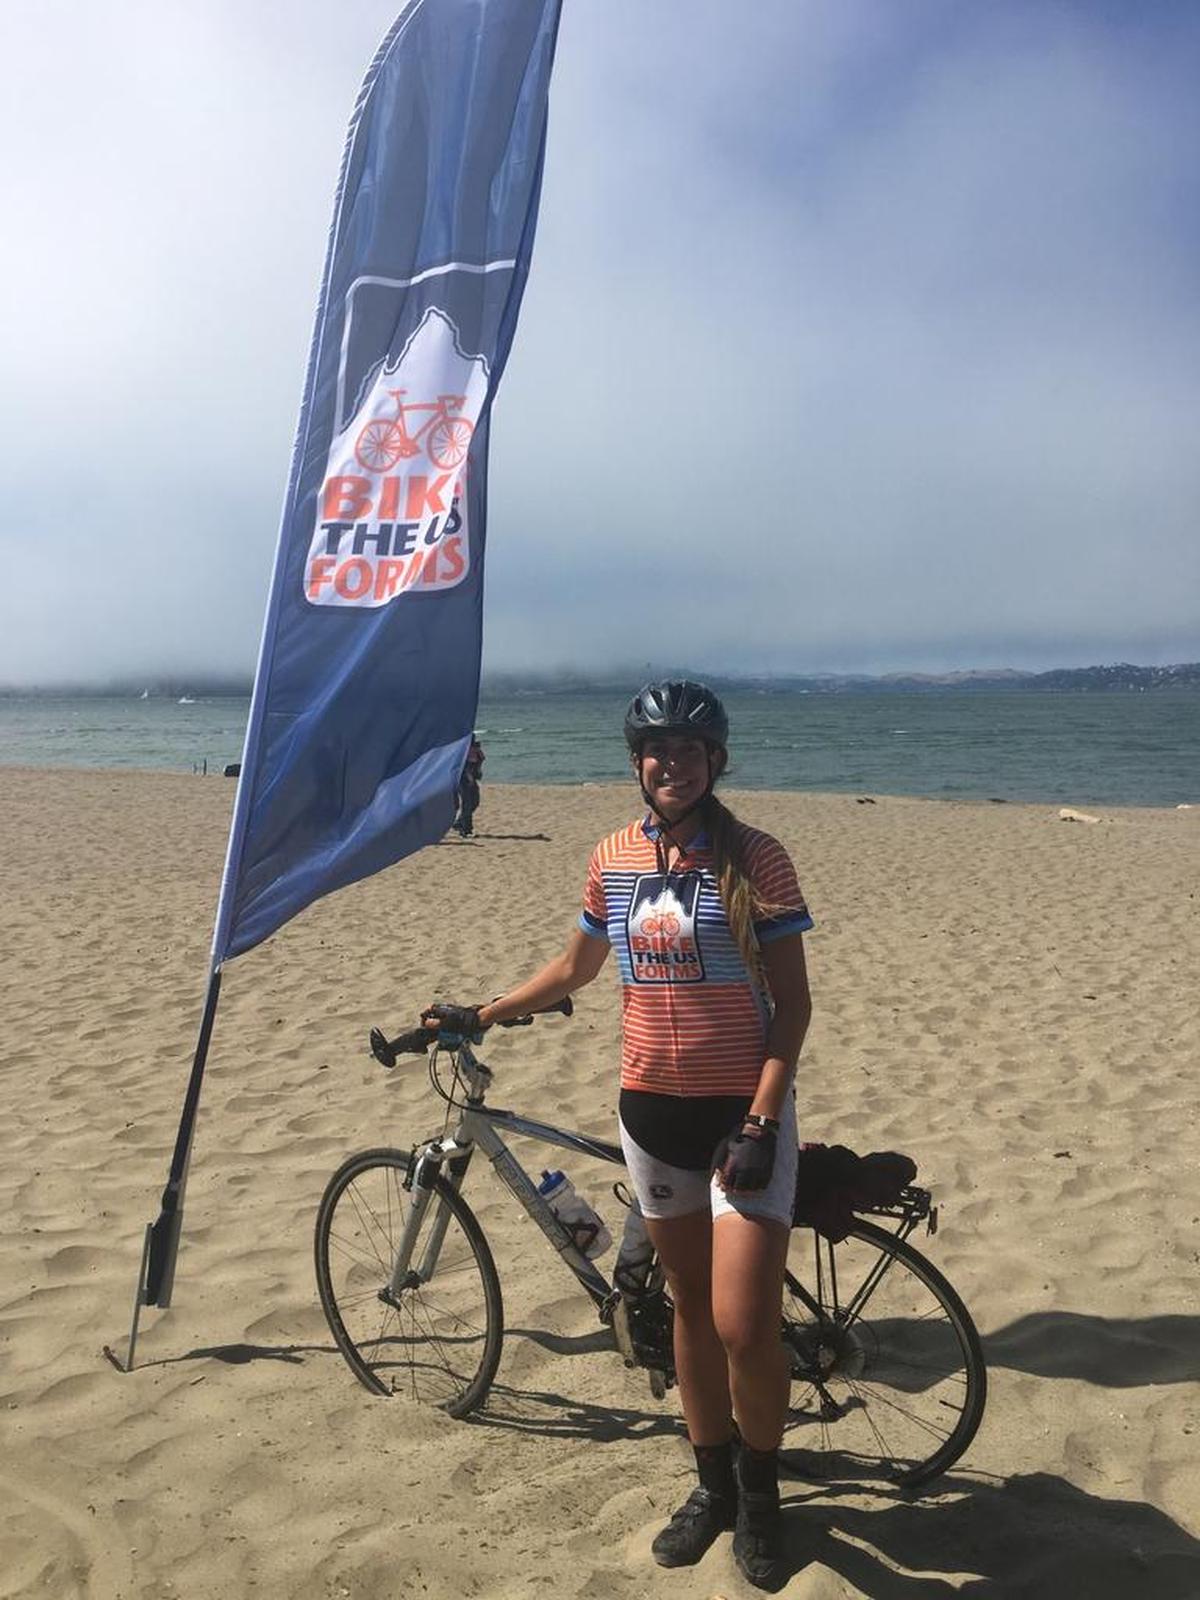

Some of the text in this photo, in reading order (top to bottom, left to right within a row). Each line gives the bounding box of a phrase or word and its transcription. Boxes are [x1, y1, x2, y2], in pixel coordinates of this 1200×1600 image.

[323, 475, 463, 519] BIK
[321, 523, 419, 555] THE
[308, 557, 405, 600] FOR
[632, 936, 692, 951] BIKE
[633, 951, 697, 964] THE US
[635, 963, 700, 978] FOR MS
